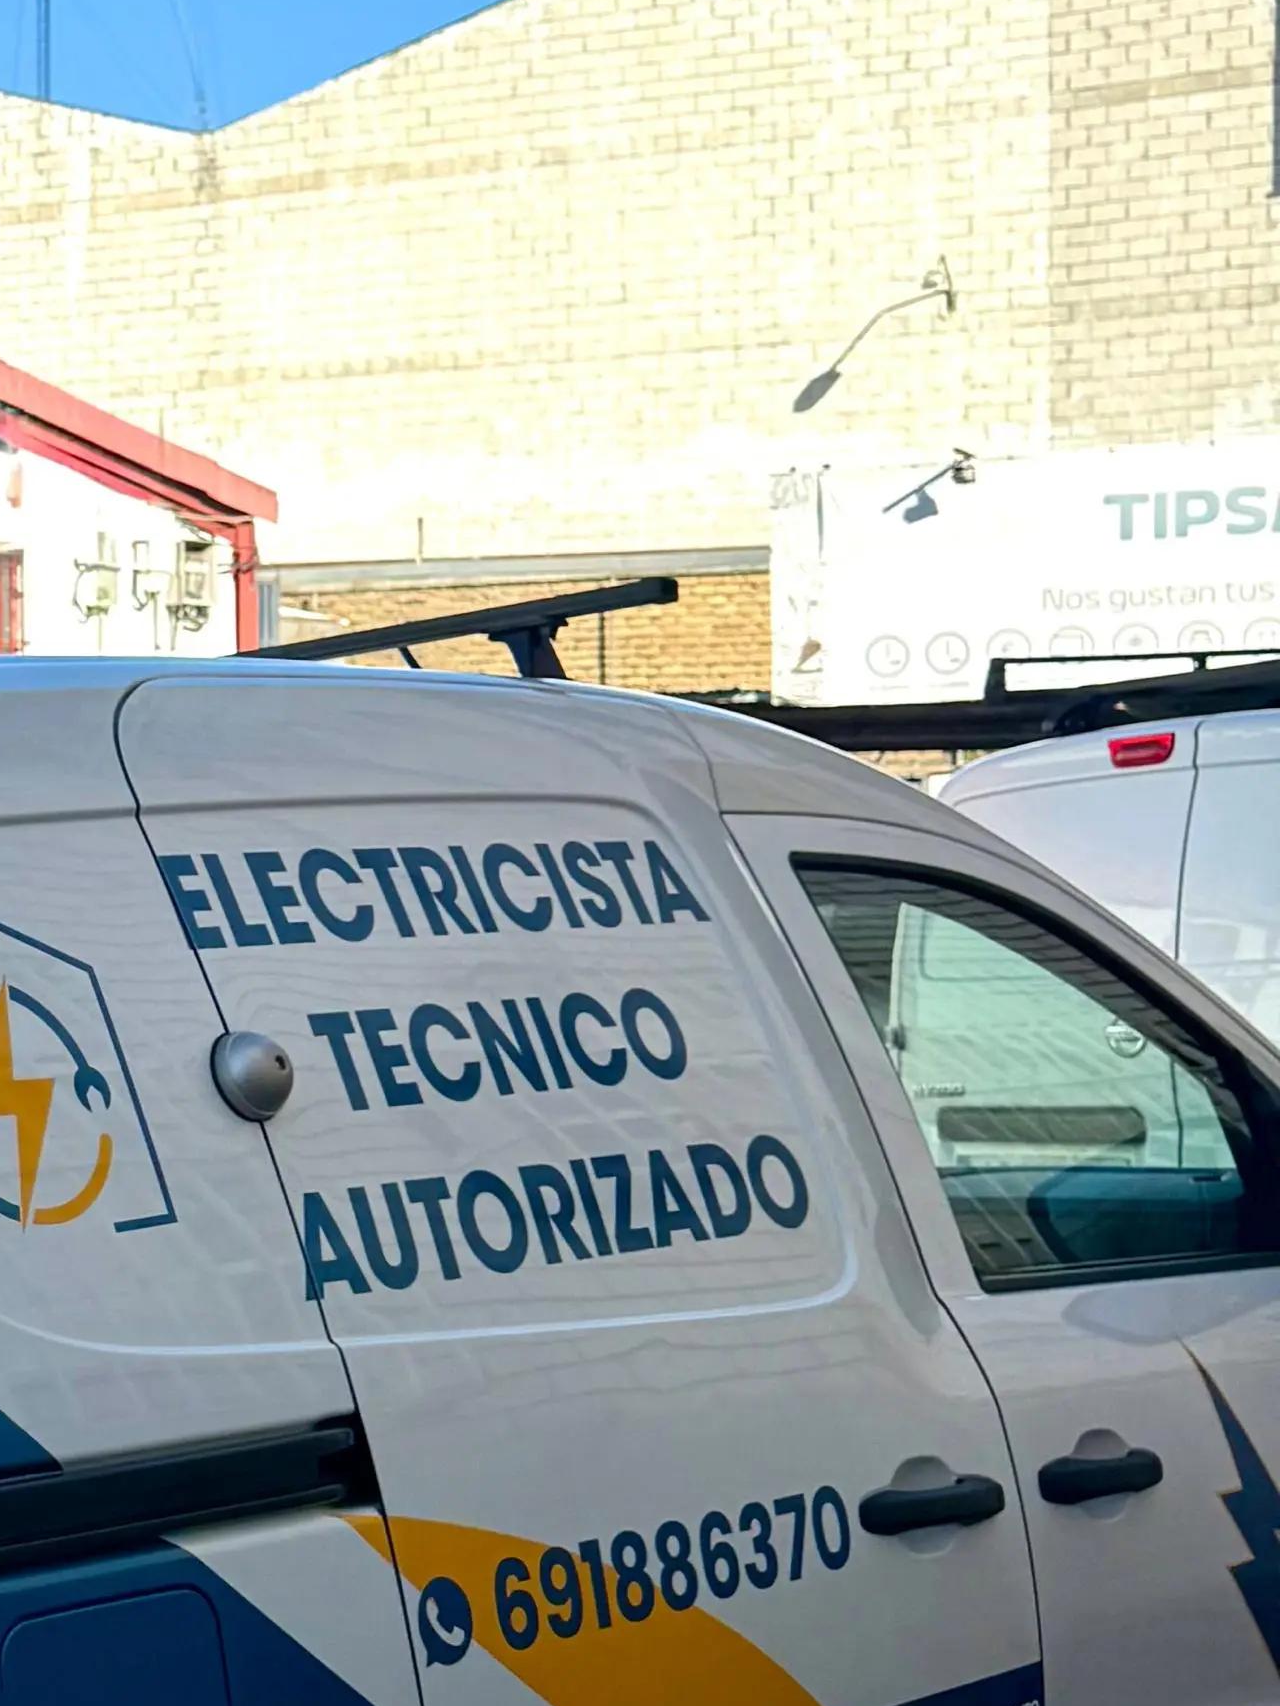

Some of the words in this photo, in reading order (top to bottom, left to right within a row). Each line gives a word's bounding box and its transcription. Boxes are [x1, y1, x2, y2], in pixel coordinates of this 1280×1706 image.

[1103, 486, 1280, 540] TIPS
[1042, 588, 1100, 611] Nos
[1109, 585, 1216, 613] gustan
[1226, 581, 1275, 604] tus
[157, 839, 711, 950] ELECTRICISTA
[308, 987, 688, 1111] TECNICO
[302, 1134, 810, 1301] AUTORIZADO
[493, 1485, 852, 1651] 691886370
